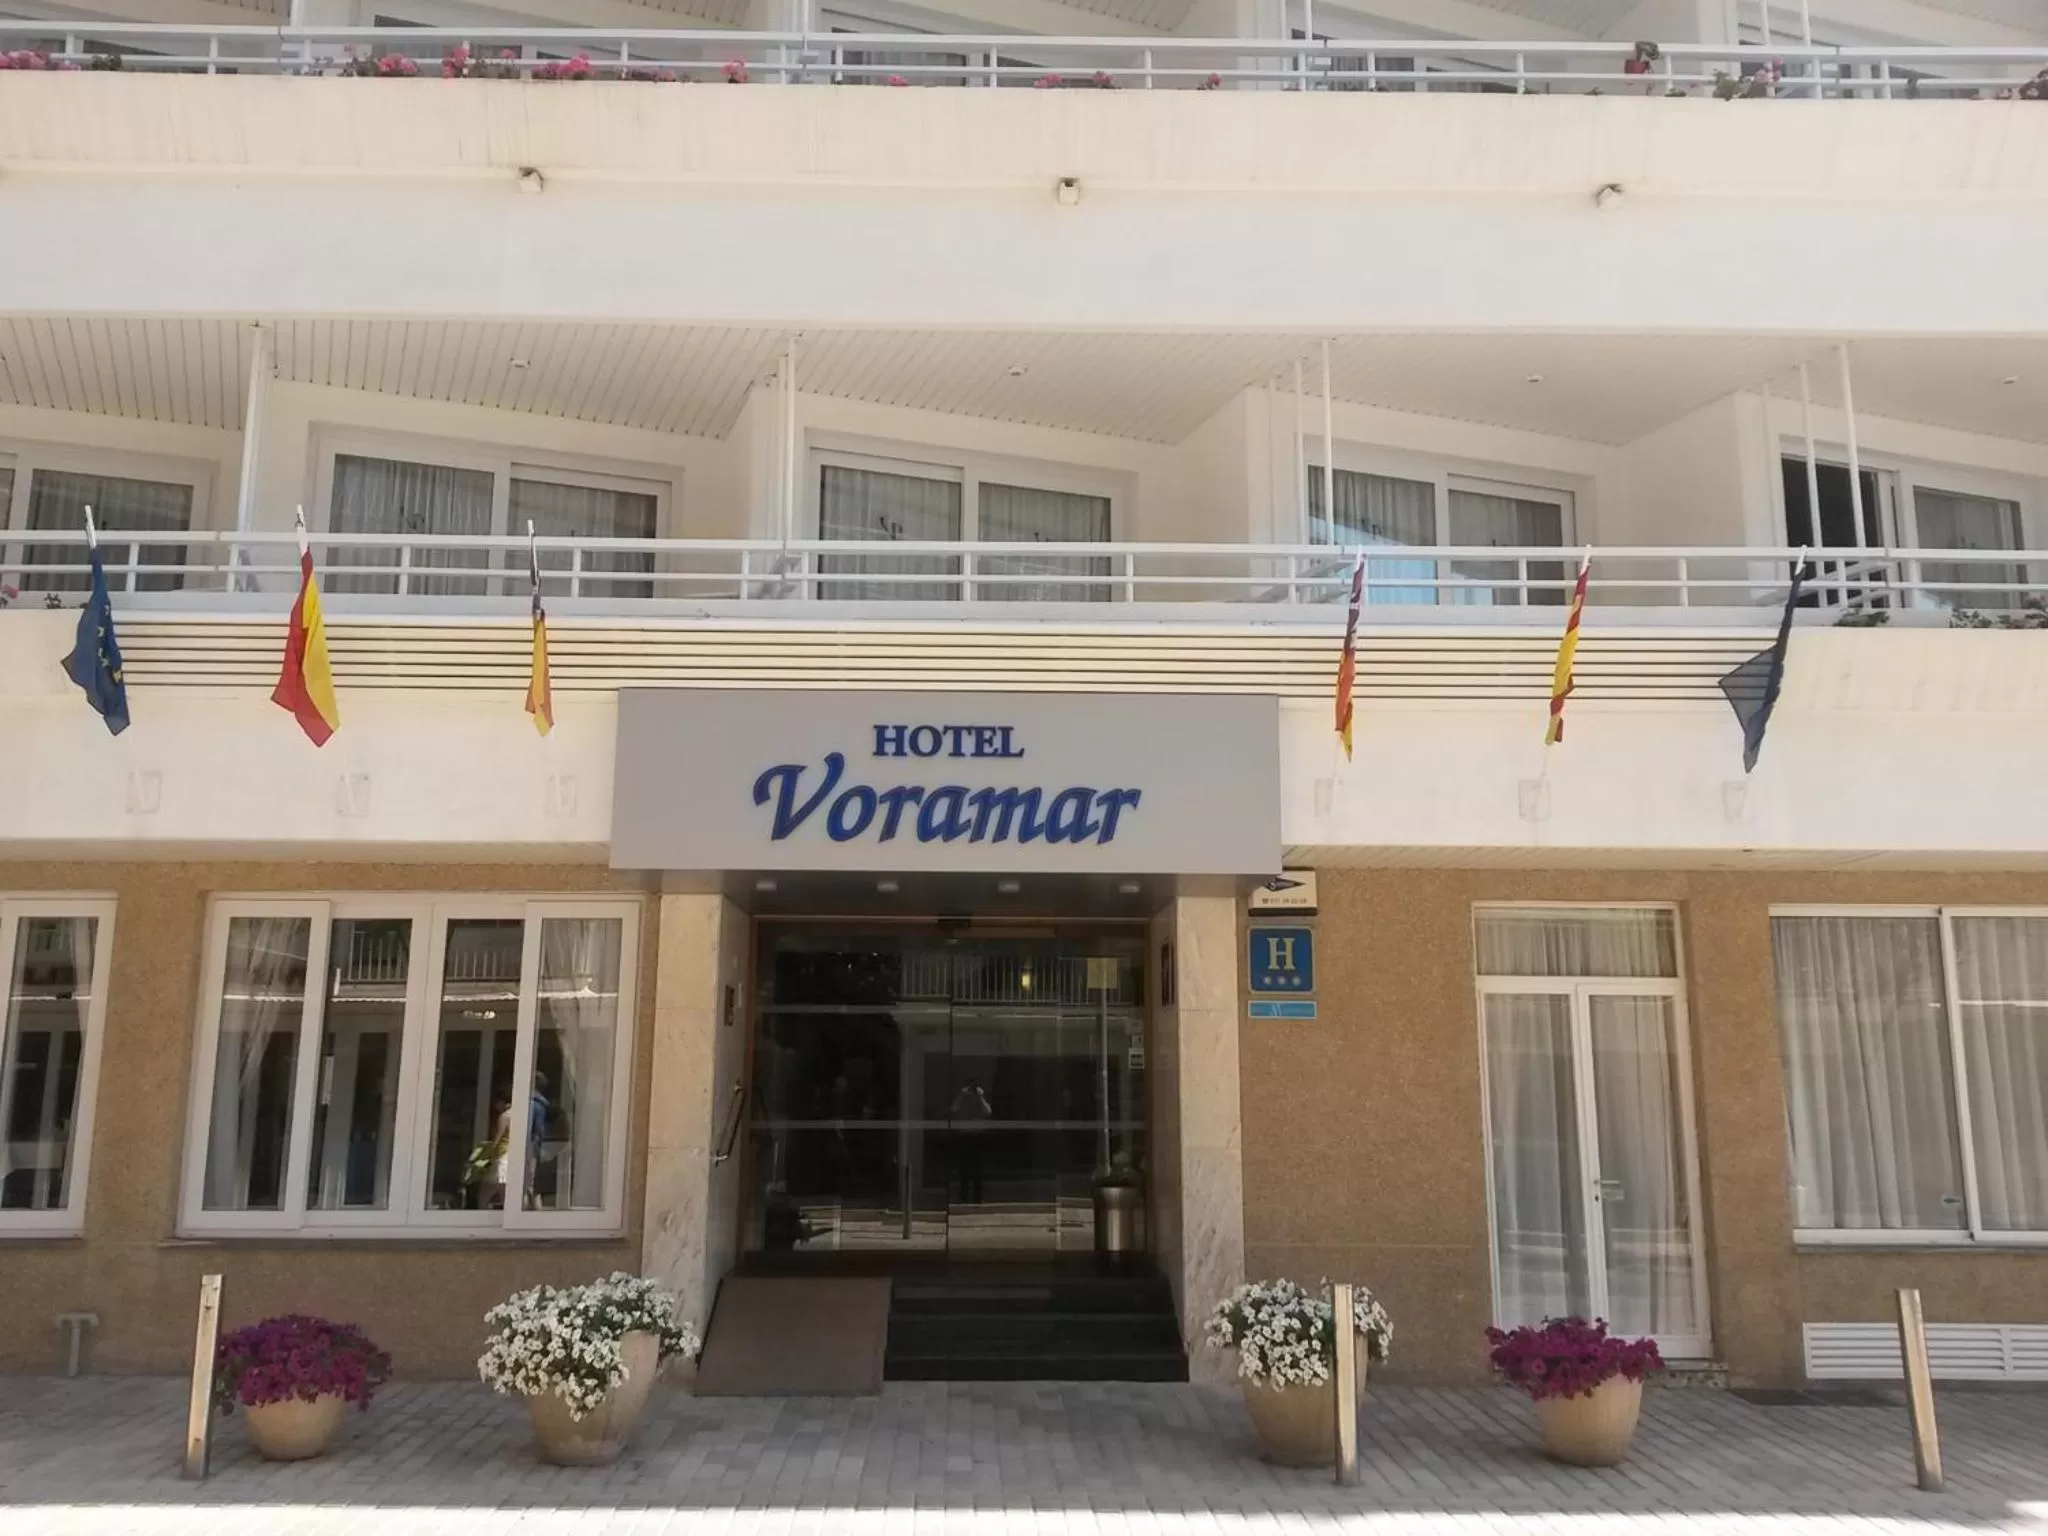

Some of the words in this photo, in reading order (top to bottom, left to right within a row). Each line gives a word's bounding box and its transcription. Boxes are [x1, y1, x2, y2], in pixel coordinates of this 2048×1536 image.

[872, 724, 1025, 758] HOTEL
[752, 751, 1142, 844] Voramar
[1266, 937, 1296, 970] H
